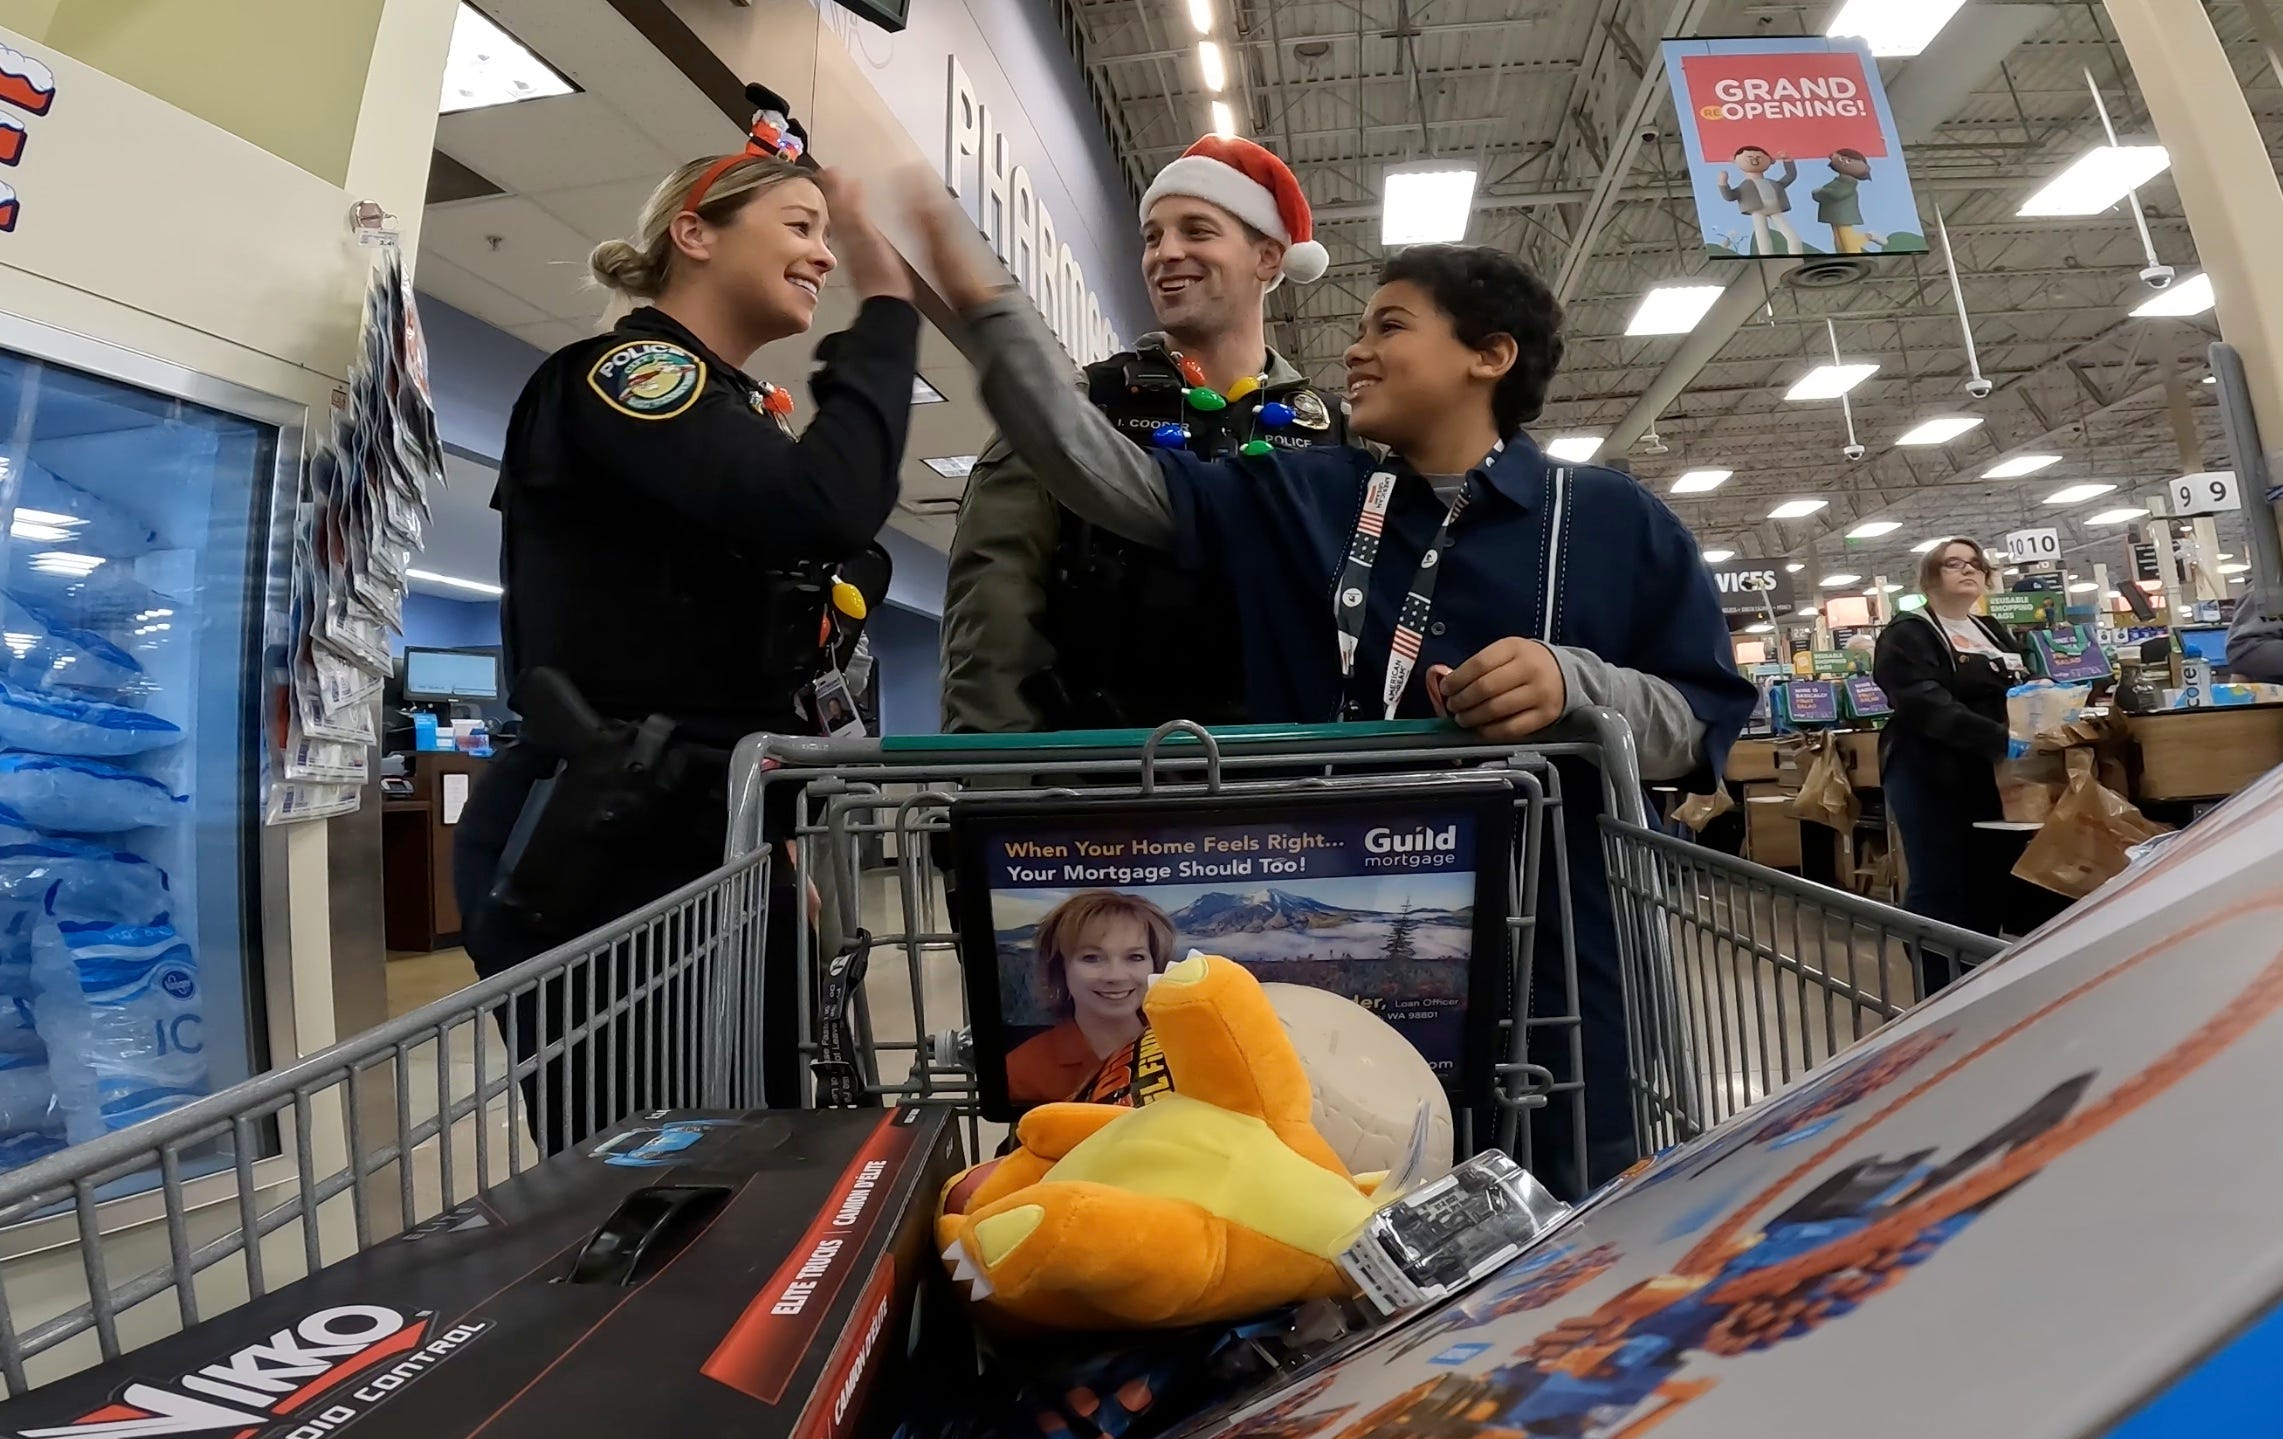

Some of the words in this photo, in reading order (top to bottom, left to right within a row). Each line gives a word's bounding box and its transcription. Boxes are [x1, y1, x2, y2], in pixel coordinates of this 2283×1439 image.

[1715, 76, 1857, 102] GRAND
[1721, 99, 1867, 121] OPENING!
[599, 344, 686, 378] POLICE
[1117, 418, 1125, 427] I.
[2180, 486, 2192, 508] 9
[2209, 481, 2227, 502] 9
[2009, 538, 2024, 557] 10
[2027, 535, 2055, 553] 10
[1386, 659, 1401, 703] AMERICAN
[2183, 667, 2199, 708] core
[1004, 841, 1068, 858] When
[1074, 840, 1125, 856] Your
[1132, 839, 1196, 855] Home
[1203, 835, 1260, 853] Feels
[1267, 832, 1345, 854] Right...
[1364, 825, 1457, 853] Guild
[1007, 866, 1056, 882] Your
[1063, 864, 1171, 883] Mortgage
[1179, 859, 1252, 877] Should
[1259, 857, 1306, 874] Too!
[1364, 853, 1456, 867] mortgage
[1387, 1012, 1405, 1020] WA
[1395, 999, 1420, 1008] Loan
[771, 1281, 818, 1316] ELITE
[796, 1238, 844, 1281] TRUCKS
[832, 1181, 870, 1227] CAMION
[16, 1303, 405, 1439] NIKKO
[350, 1320, 487, 1403] CONTROL
[834, 1350, 866, 1426] CAMION
